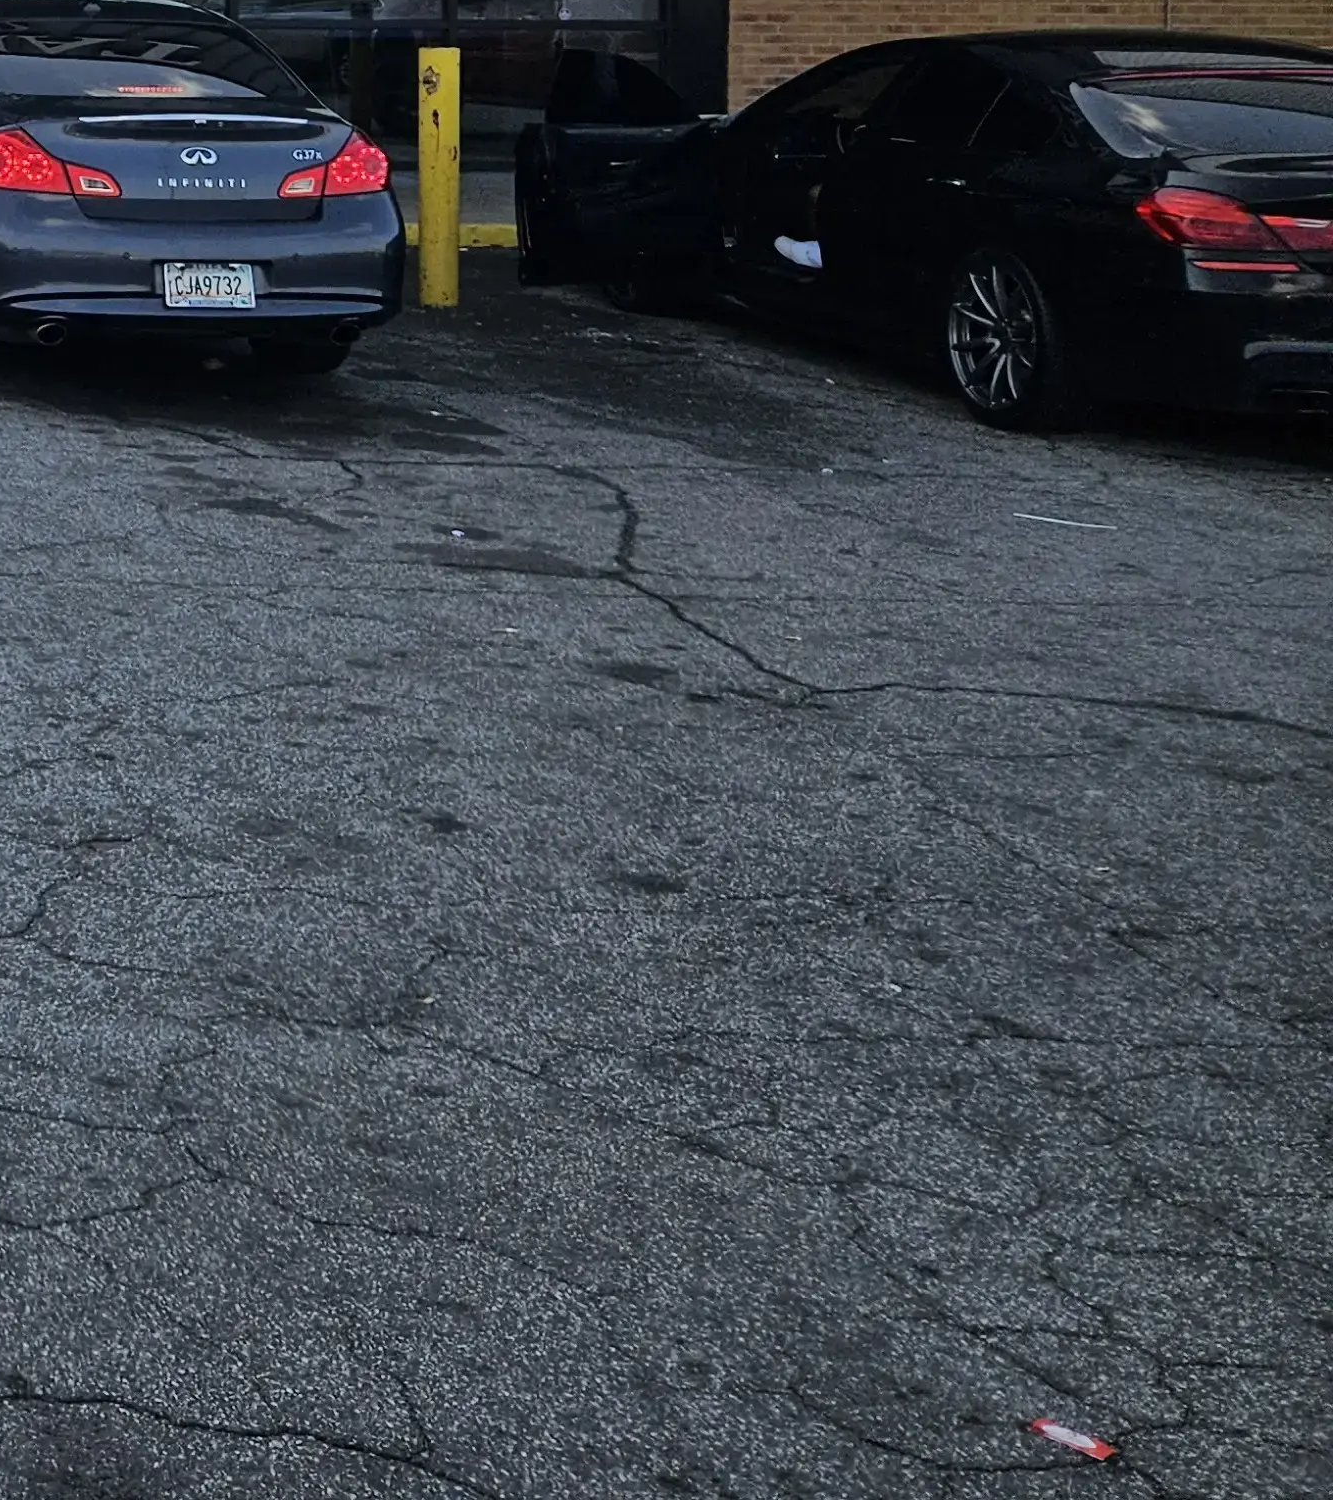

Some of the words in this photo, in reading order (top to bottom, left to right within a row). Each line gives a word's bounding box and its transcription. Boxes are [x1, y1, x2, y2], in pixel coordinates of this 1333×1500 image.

[293, 149, 323, 161] G37x
[157, 178, 247, 188] INFINITI
[174, 275, 243, 296] CJA9732
